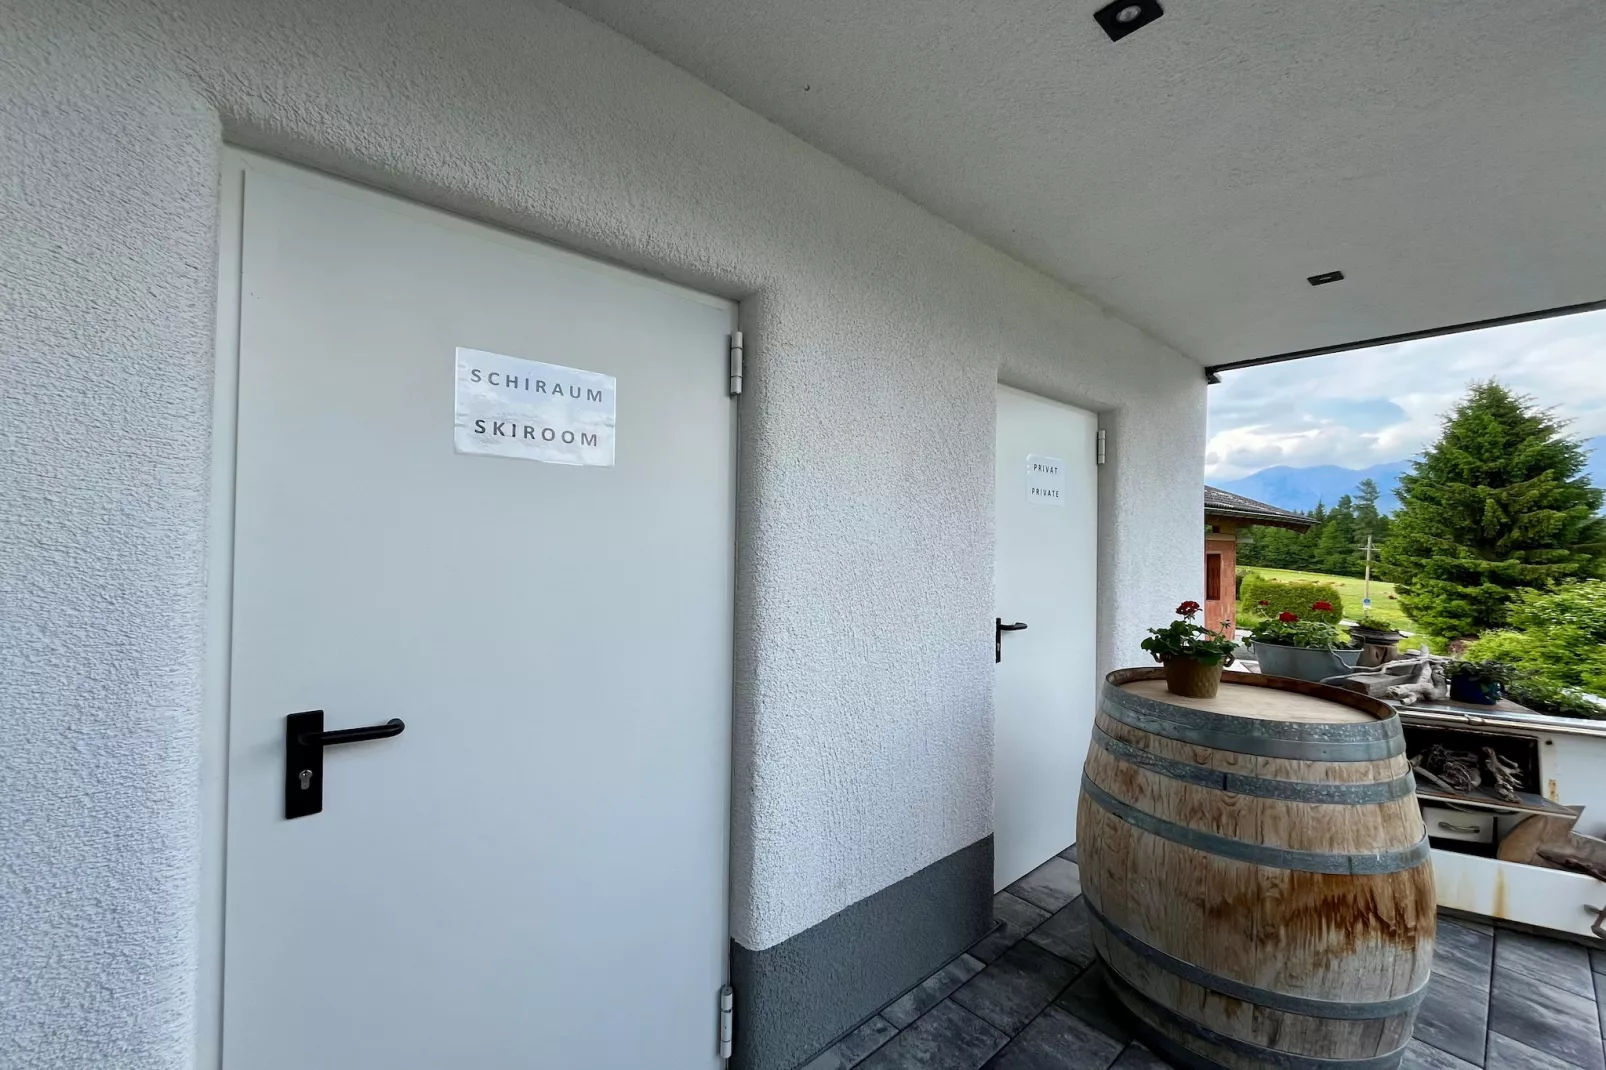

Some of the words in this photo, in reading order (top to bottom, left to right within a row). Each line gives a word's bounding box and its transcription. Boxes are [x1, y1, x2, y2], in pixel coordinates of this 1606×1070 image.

[470, 368, 602, 403] SCHIRAUM
[474, 419, 597, 447] SKIROOM
[1033, 463, 1058, 474] PRIVAT
[1031, 487, 1059, 498] PRIVATE
